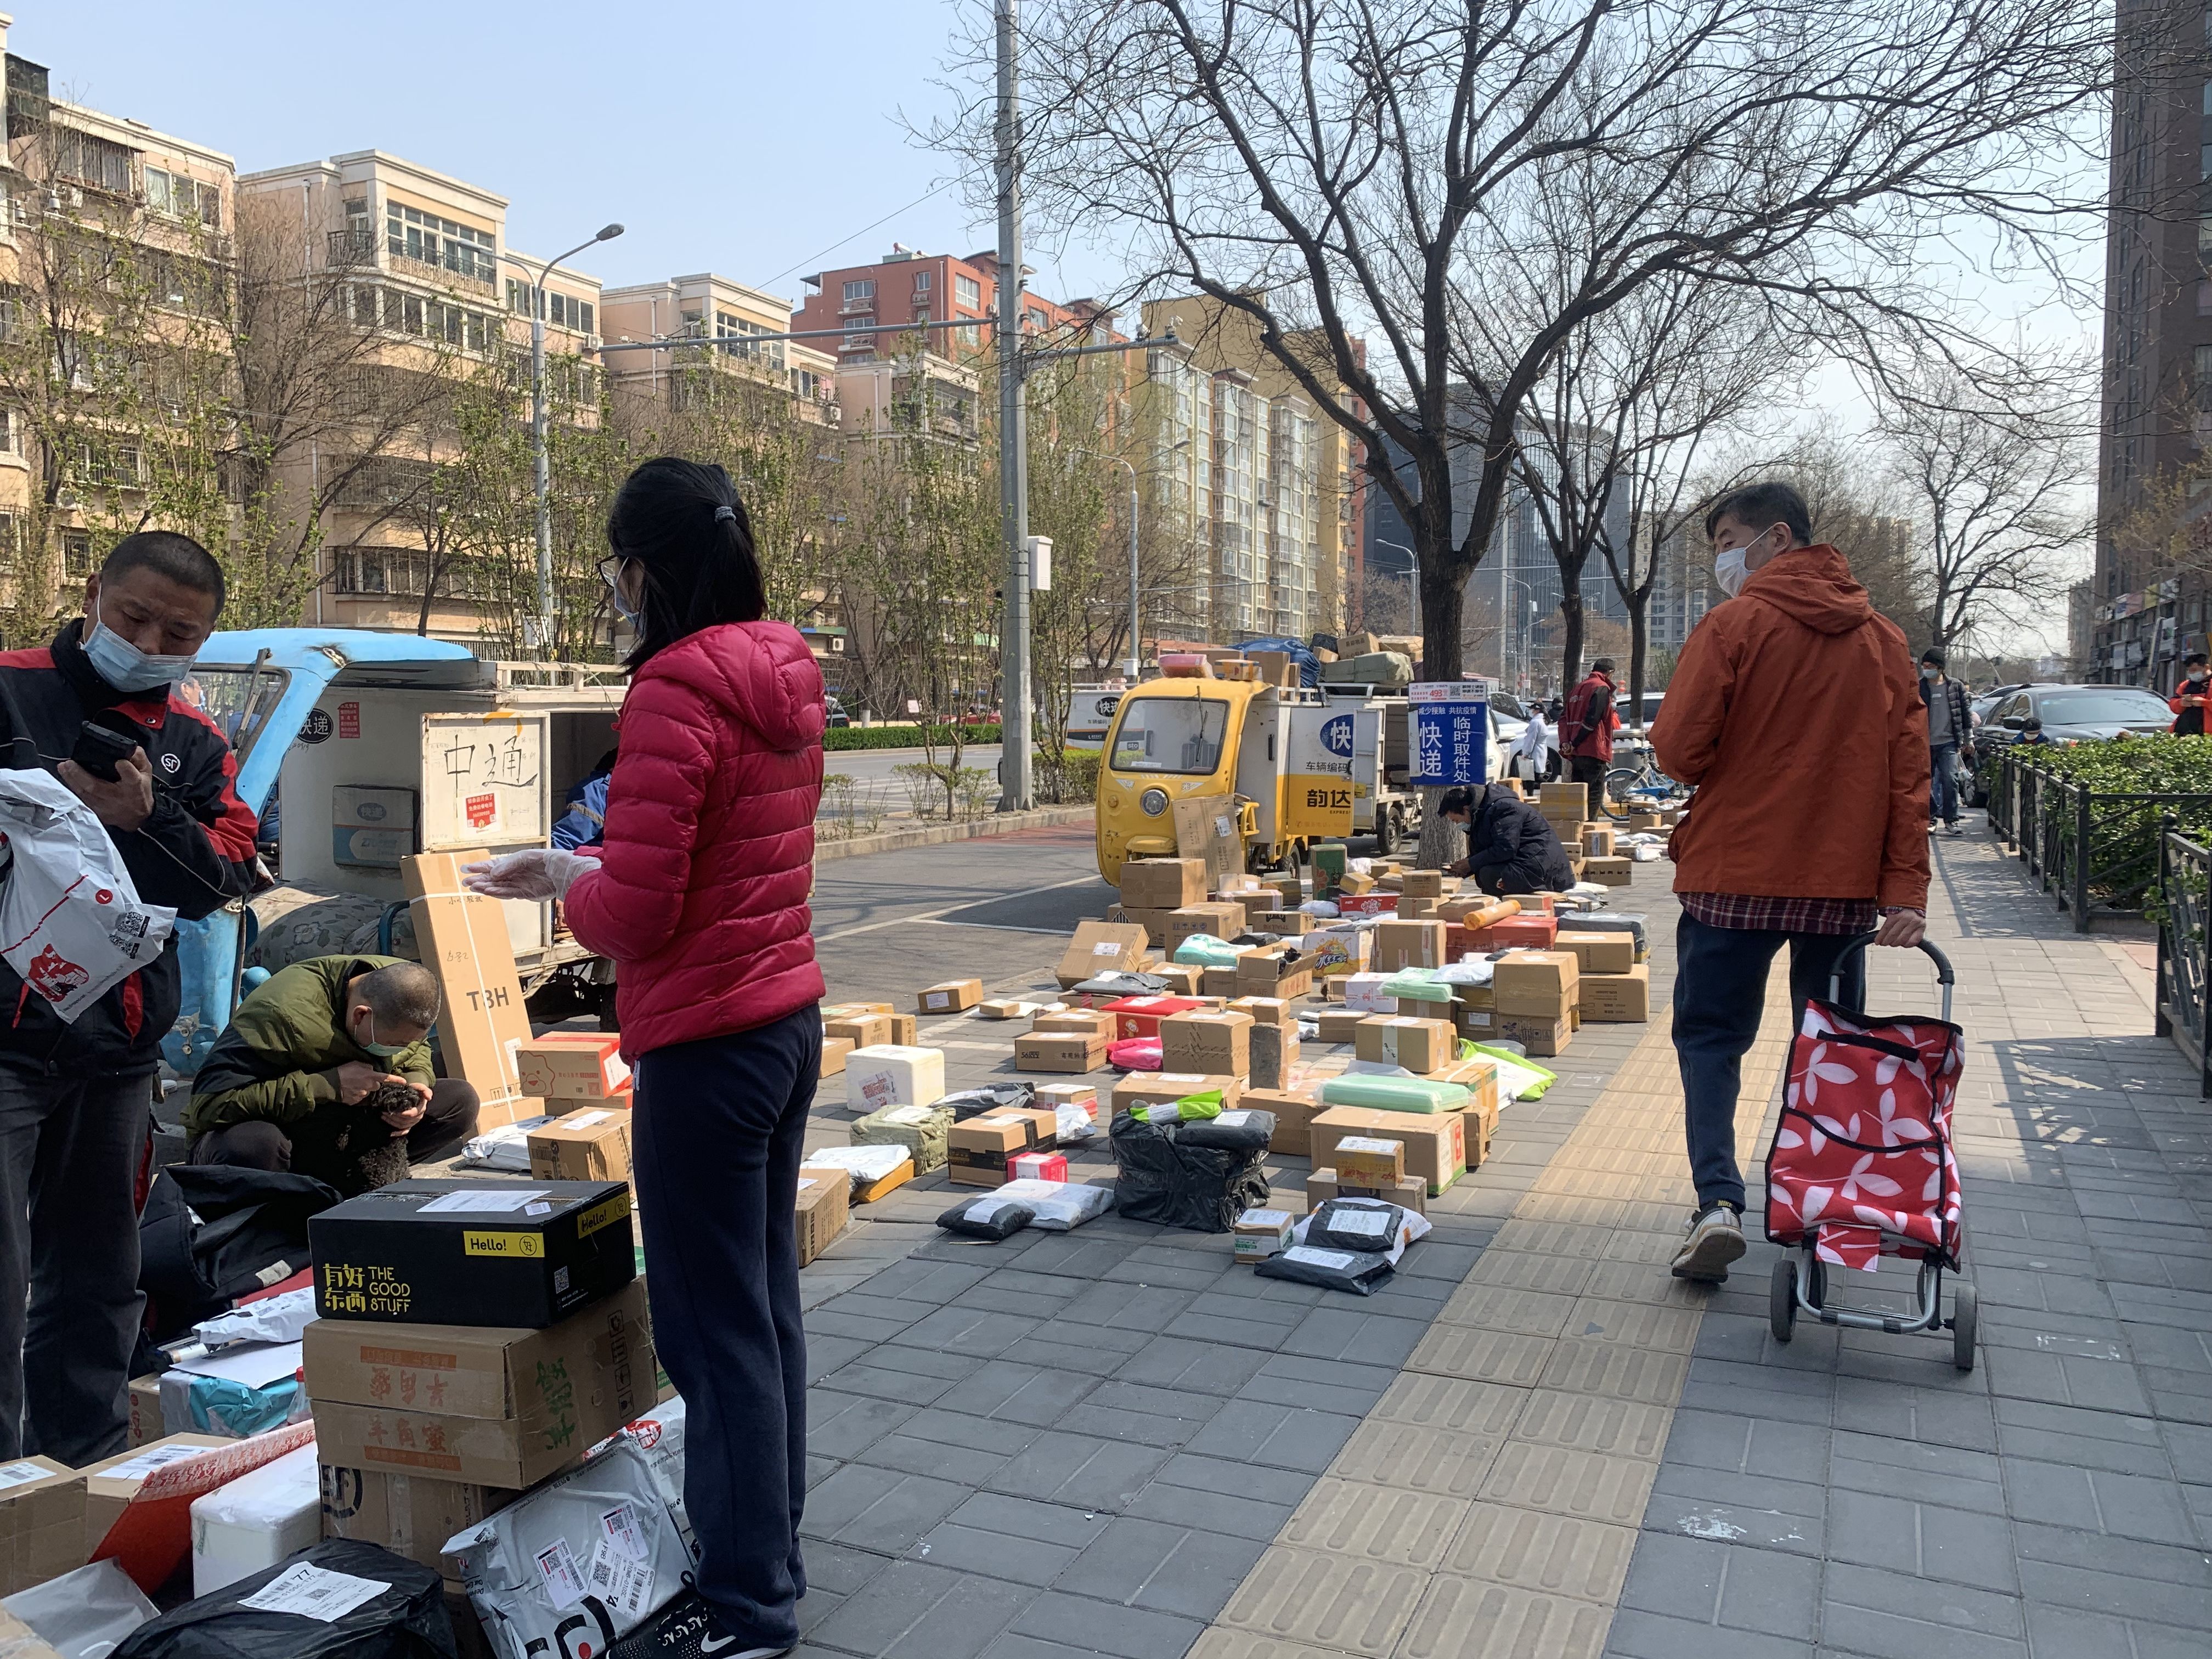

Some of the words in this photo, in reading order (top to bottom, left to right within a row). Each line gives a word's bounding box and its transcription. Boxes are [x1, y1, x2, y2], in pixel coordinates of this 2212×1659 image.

[1419, 707, 1446, 715] 减少接触
[1449, 707, 1477, 715] 共抗疫情
[1330, 721, 1351, 750] 快
[1419, 721, 1442, 777] 快递
[1454, 716, 1471, 783] 临时取件处
[444, 734, 538, 818] 中通
[1306, 761, 1351, 773] 车辆编码
[1307, 789, 1351, 808] 韵达
[582, 1209, 607, 1232] Hello!
[470, 1238, 507, 1251] Hello!
[323, 1263, 365, 1288] 有好
[368, 1266, 395, 1281] THE
[324, 1287, 366, 1312] 东西
[369, 1282, 410, 1297] GOOD
[371, 1297, 411, 1312] STUFF
